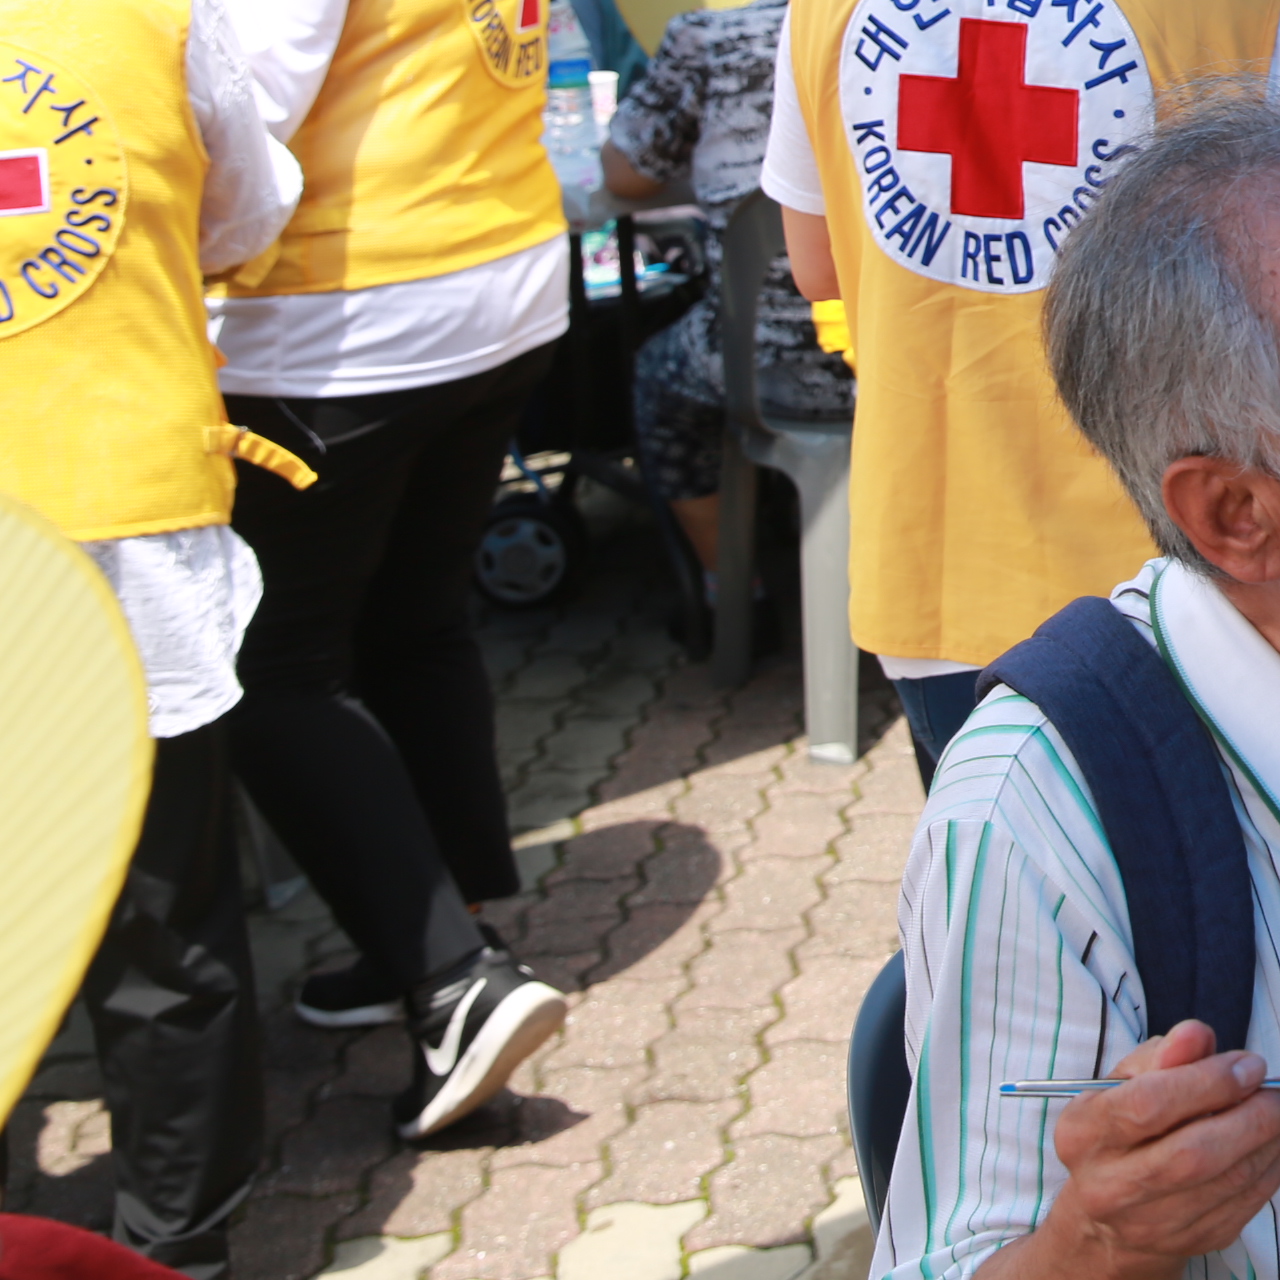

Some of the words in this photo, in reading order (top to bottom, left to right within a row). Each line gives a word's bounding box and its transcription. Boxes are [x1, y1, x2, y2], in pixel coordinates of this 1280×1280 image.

[20, 186, 118, 300] CROSS
[852, 119, 952, 267] KOREAN
[960, 230, 1034, 285] RED
